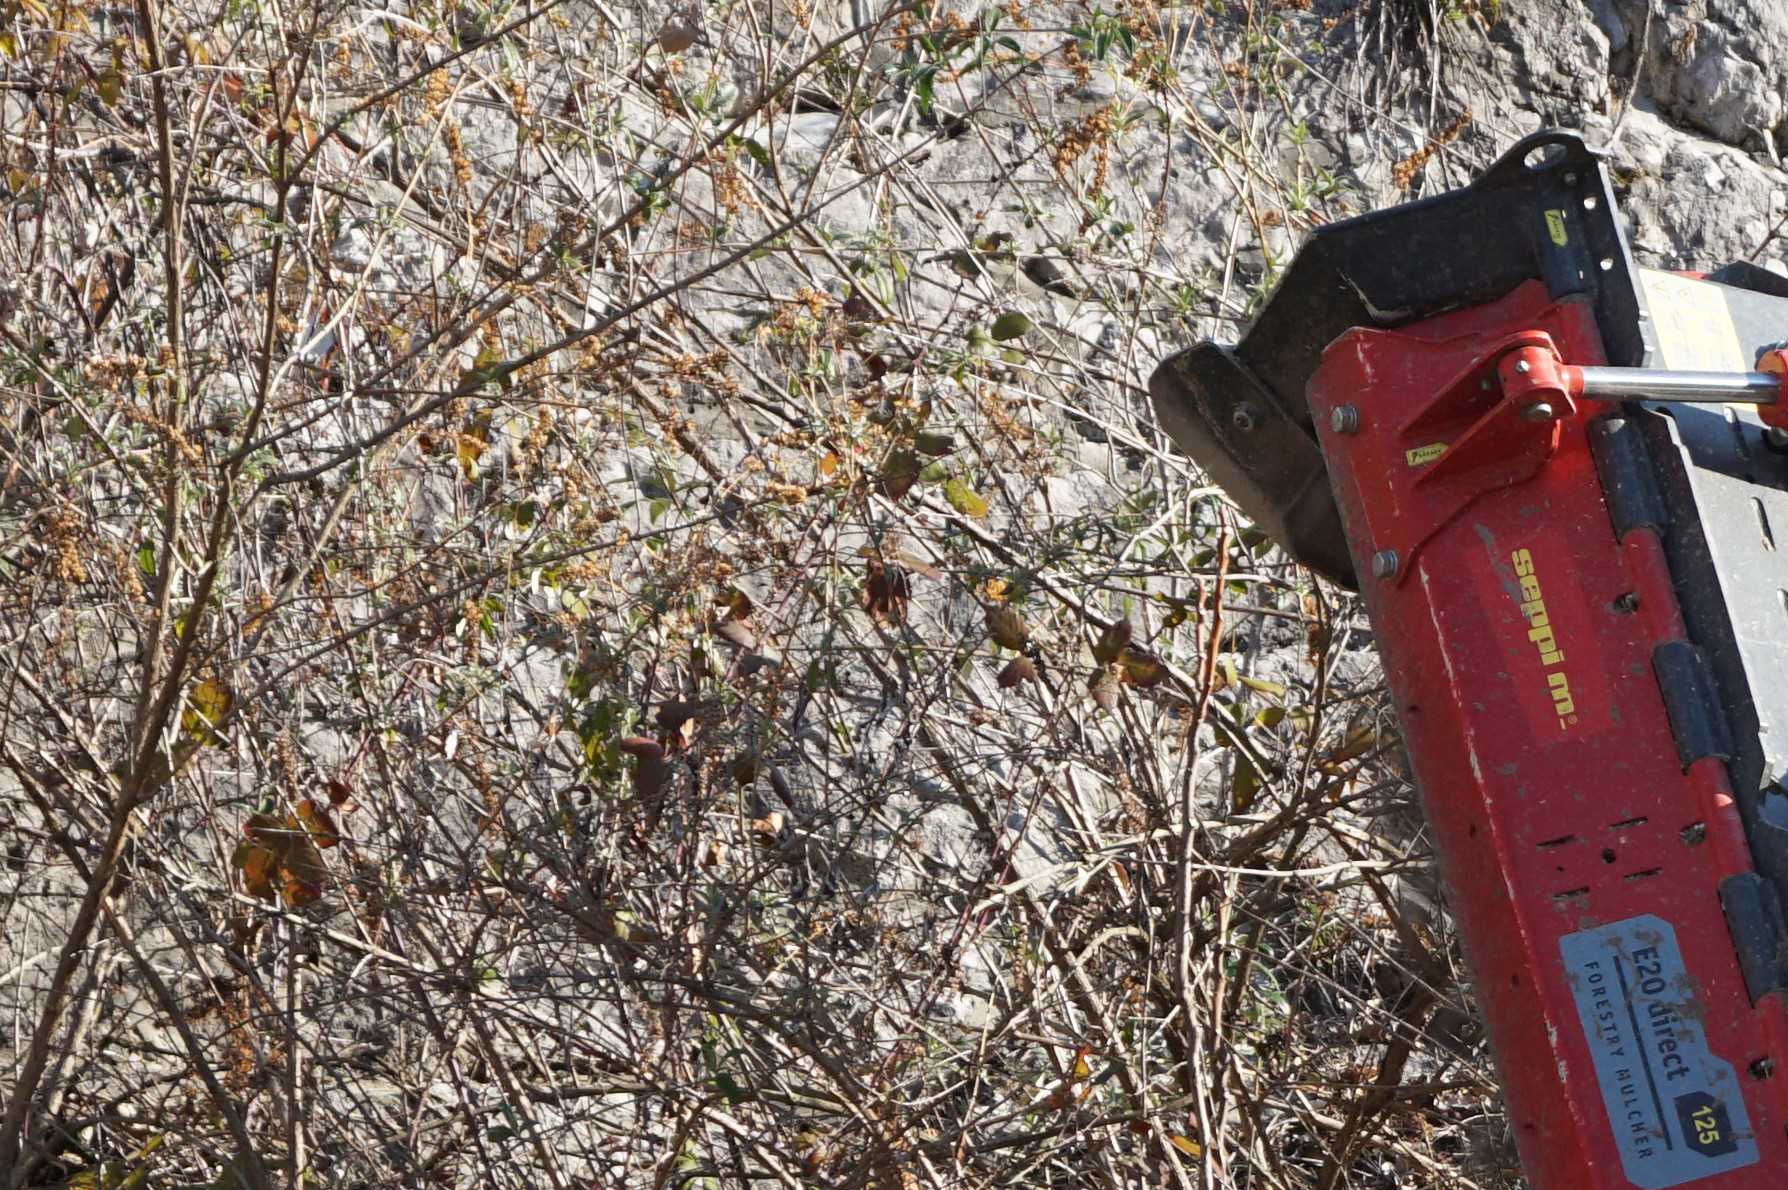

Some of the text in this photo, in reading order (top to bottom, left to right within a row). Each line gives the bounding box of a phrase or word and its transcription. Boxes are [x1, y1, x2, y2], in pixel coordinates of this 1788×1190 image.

[1511, 547, 1565, 666] seppi
[1583, 961, 1653, 1160] FORESTRY MULCHER
[1631, 946, 1691, 1082] E20 direct
[1690, 1104, 1720, 1145] 125
